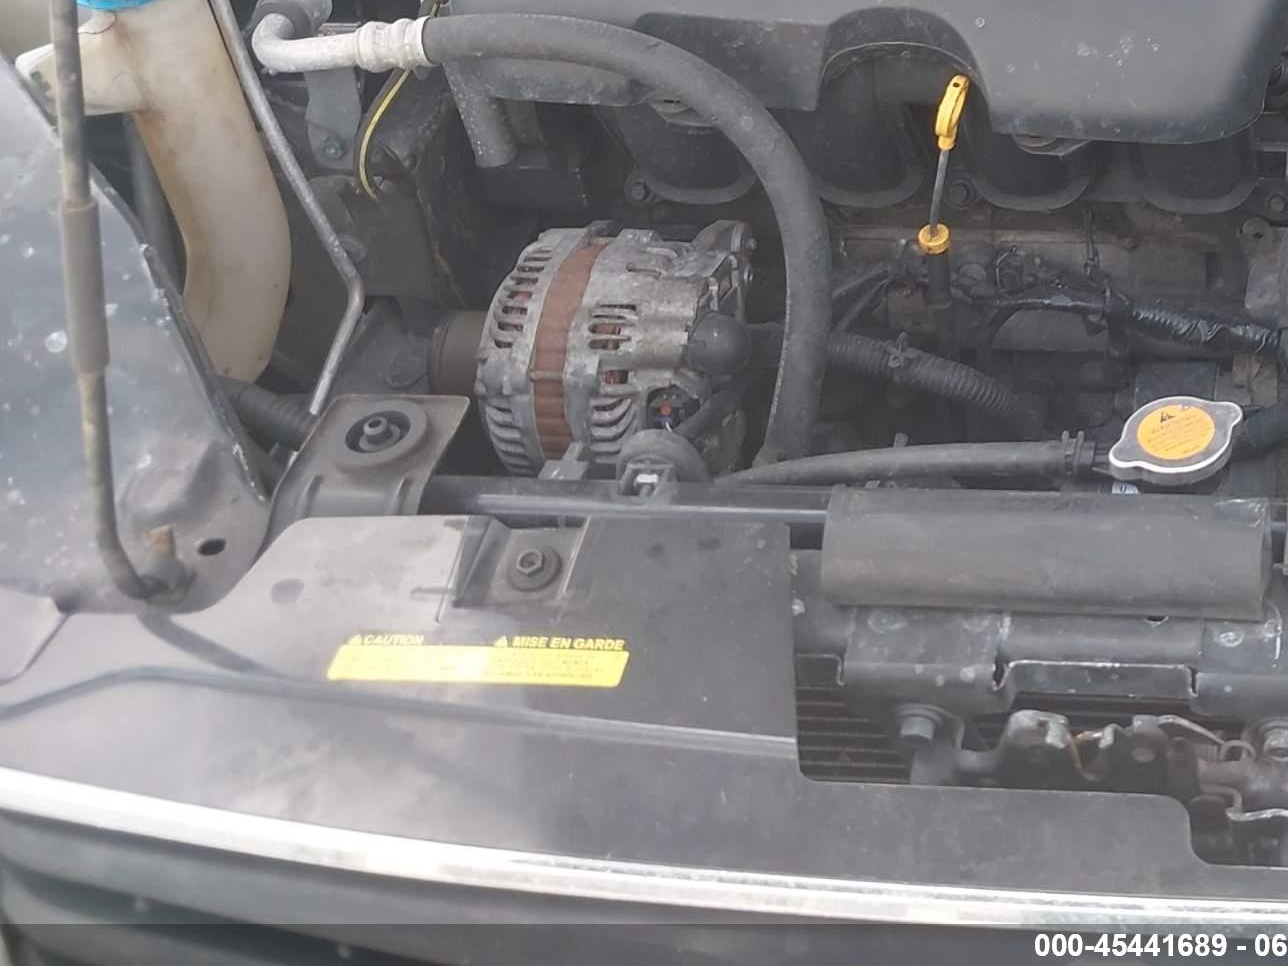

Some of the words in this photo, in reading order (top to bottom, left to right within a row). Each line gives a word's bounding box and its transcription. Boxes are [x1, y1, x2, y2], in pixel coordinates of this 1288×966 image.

[363, 634, 425, 645] CAUTION
[512, 636, 549, 648] MISE
[550, 637, 572, 649] EN
[573, 638, 625, 651] GARDE
